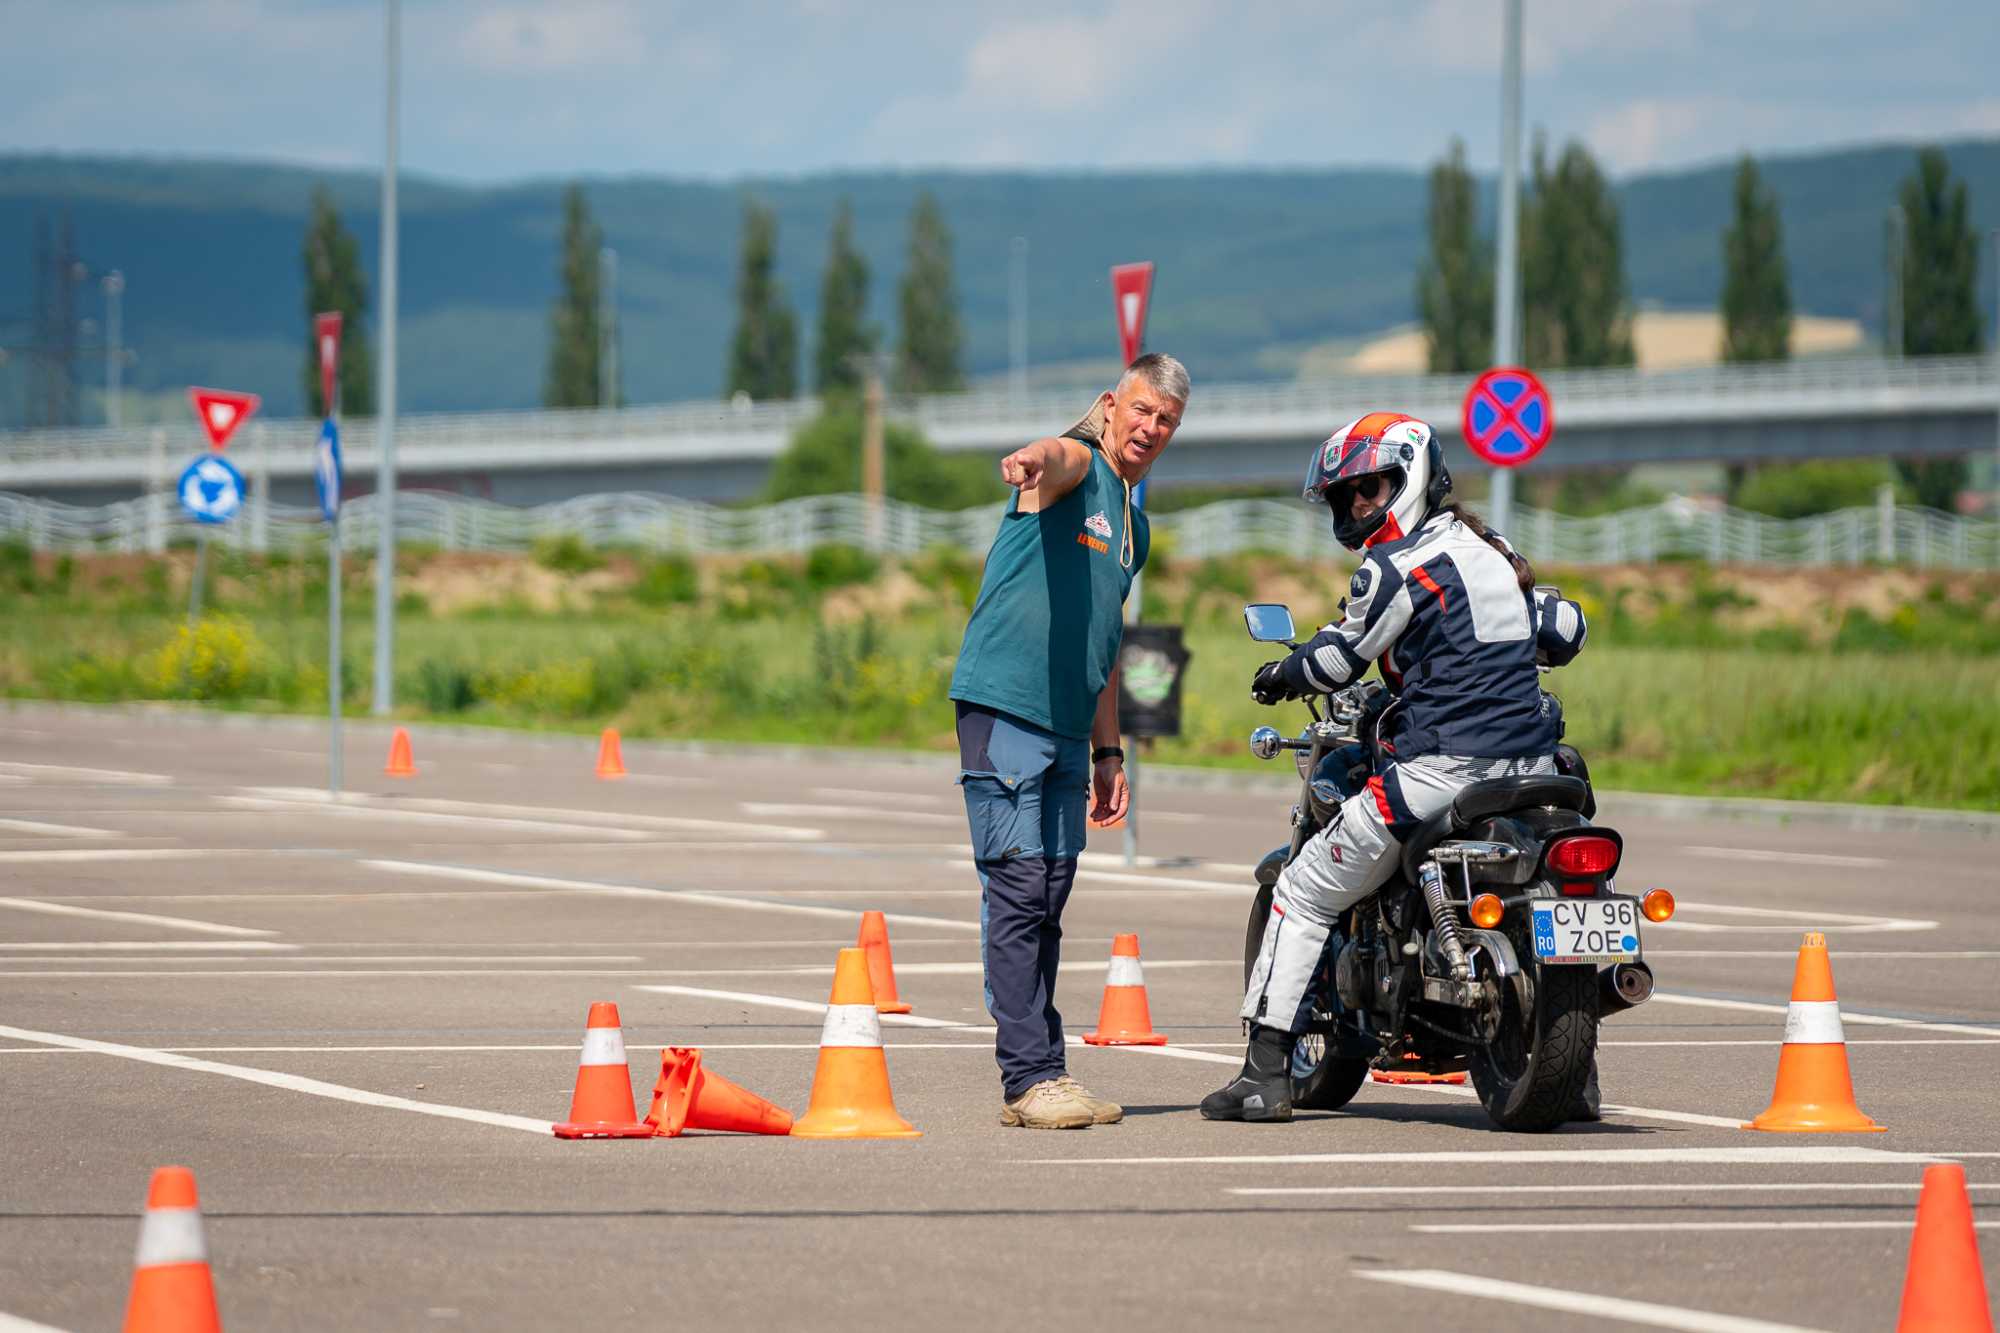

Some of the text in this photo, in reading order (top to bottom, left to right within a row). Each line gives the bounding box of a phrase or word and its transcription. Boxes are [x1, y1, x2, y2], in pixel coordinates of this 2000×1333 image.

[1554, 903, 1632, 926] CV 96
[1538, 936, 1554, 951] RO
[1570, 930, 1623, 953] ZOE
